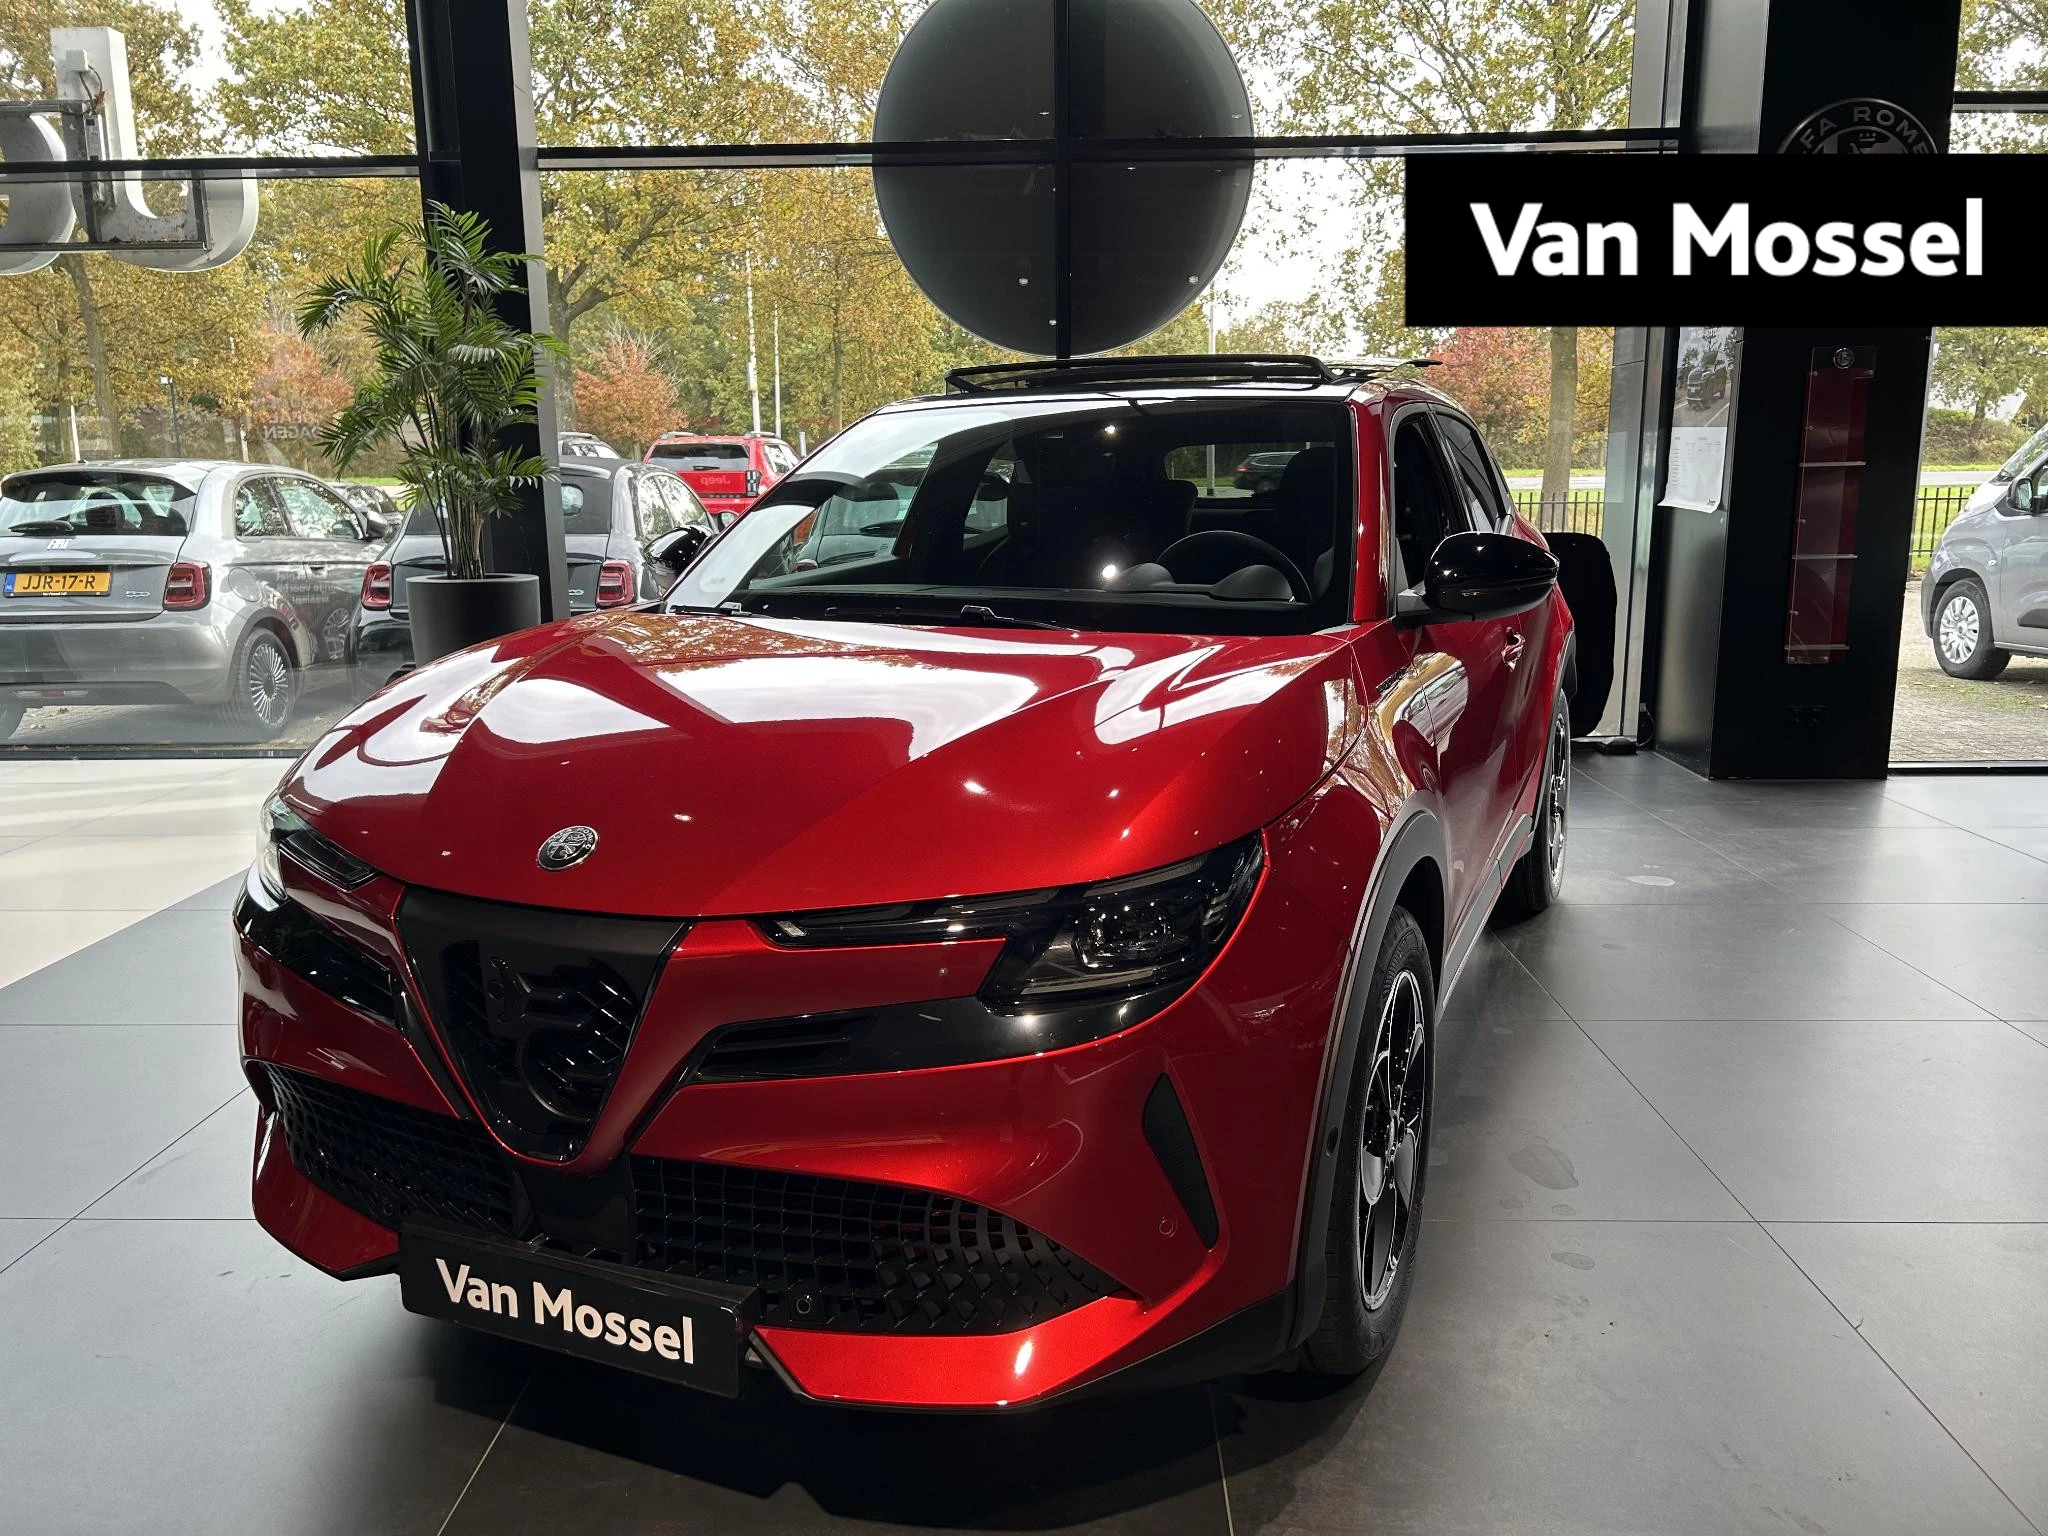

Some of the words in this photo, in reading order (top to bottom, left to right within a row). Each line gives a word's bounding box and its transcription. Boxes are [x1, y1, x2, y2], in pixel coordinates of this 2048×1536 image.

[47, 538, 73, 550] FIAT
[22, 575, 96, 590] JJR-17-R
[435, 1257, 519, 1319] Van
[532, 1281, 695, 1365] Mossel
